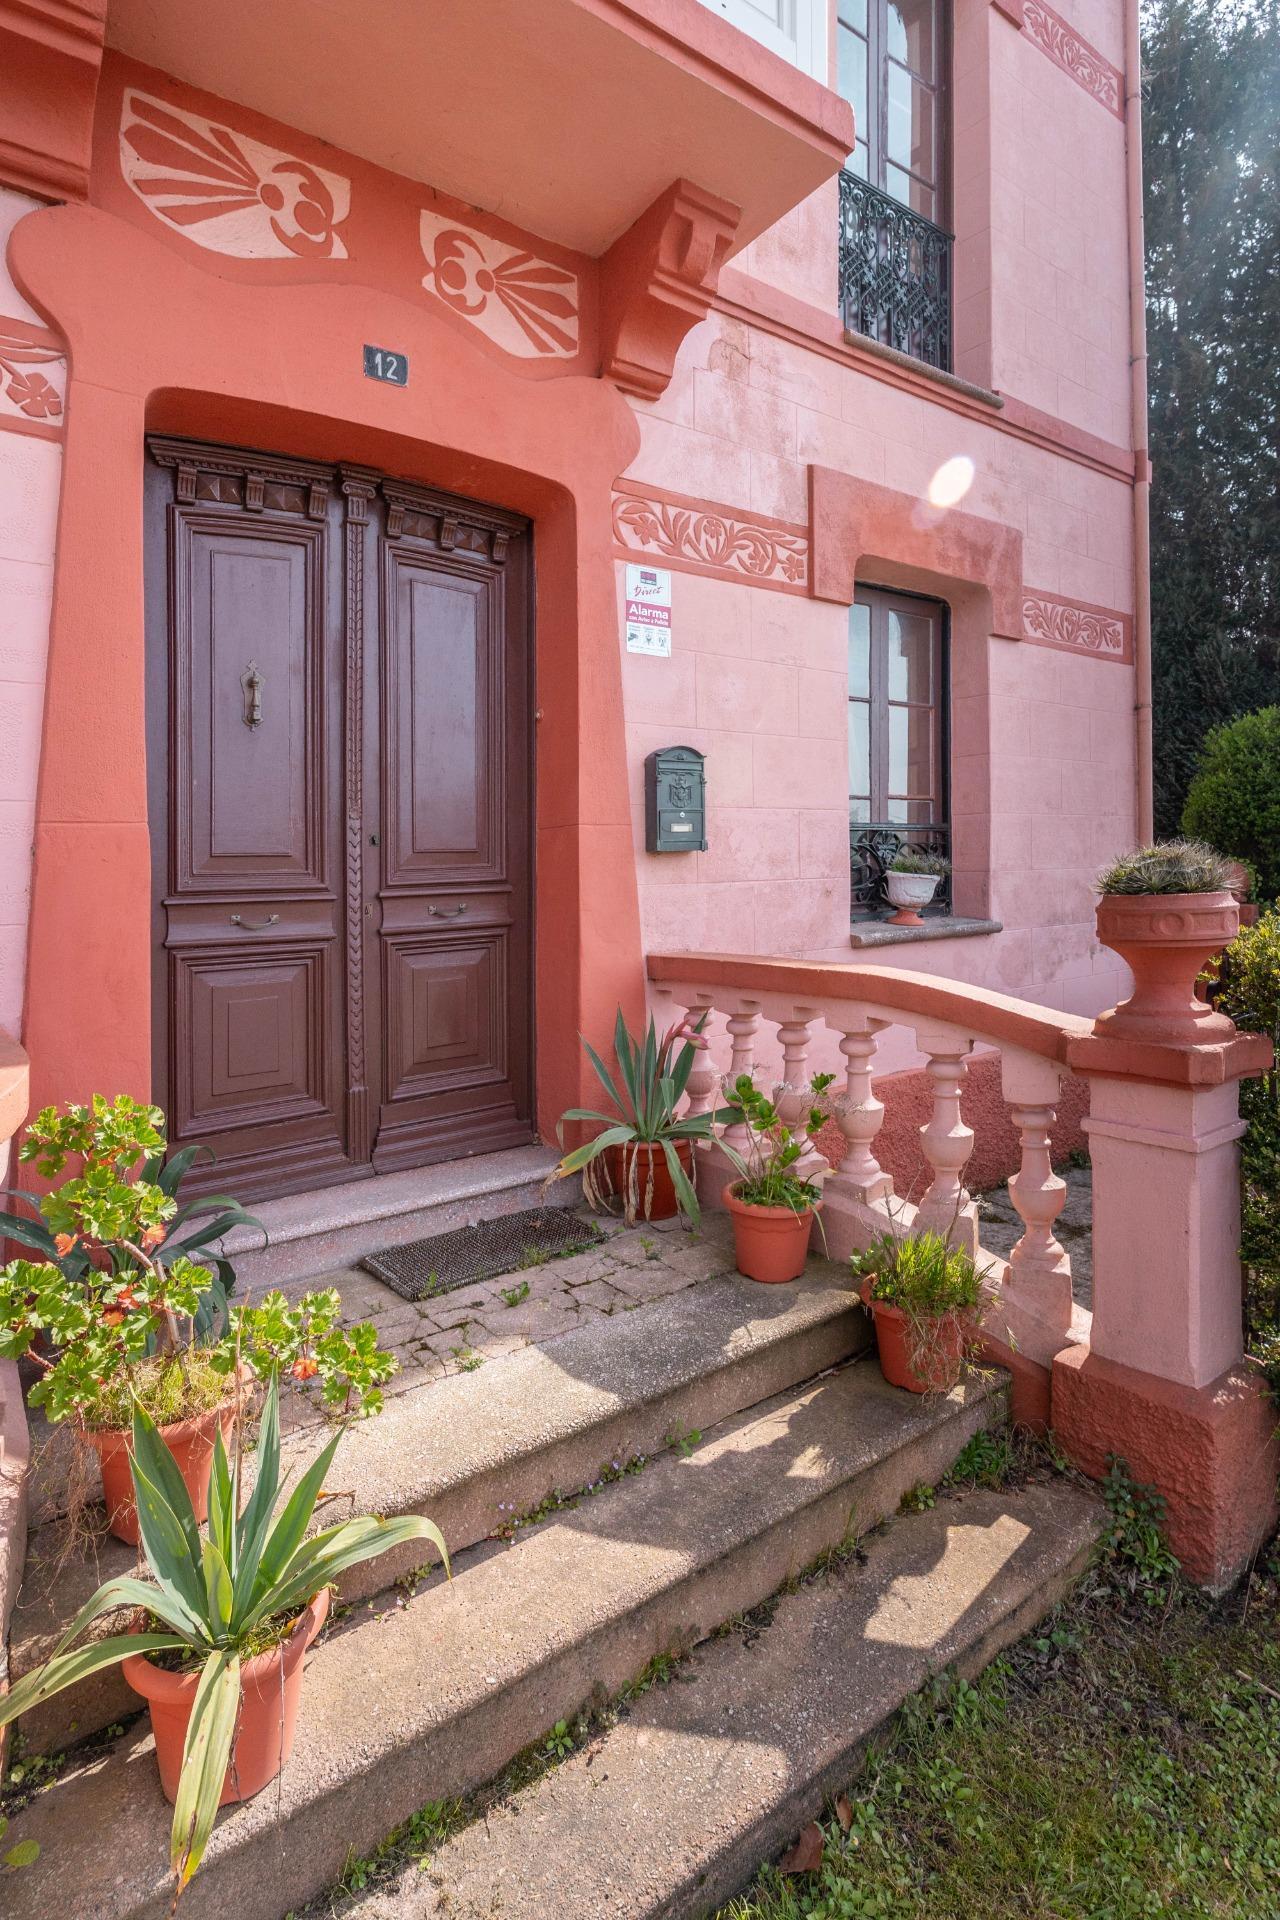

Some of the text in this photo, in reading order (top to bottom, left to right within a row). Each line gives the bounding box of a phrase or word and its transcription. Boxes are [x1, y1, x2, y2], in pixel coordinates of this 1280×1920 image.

[374, 352, 398, 380] 12
[633, 584, 664, 597] Direct
[629, 603, 668, 620] Alarma
